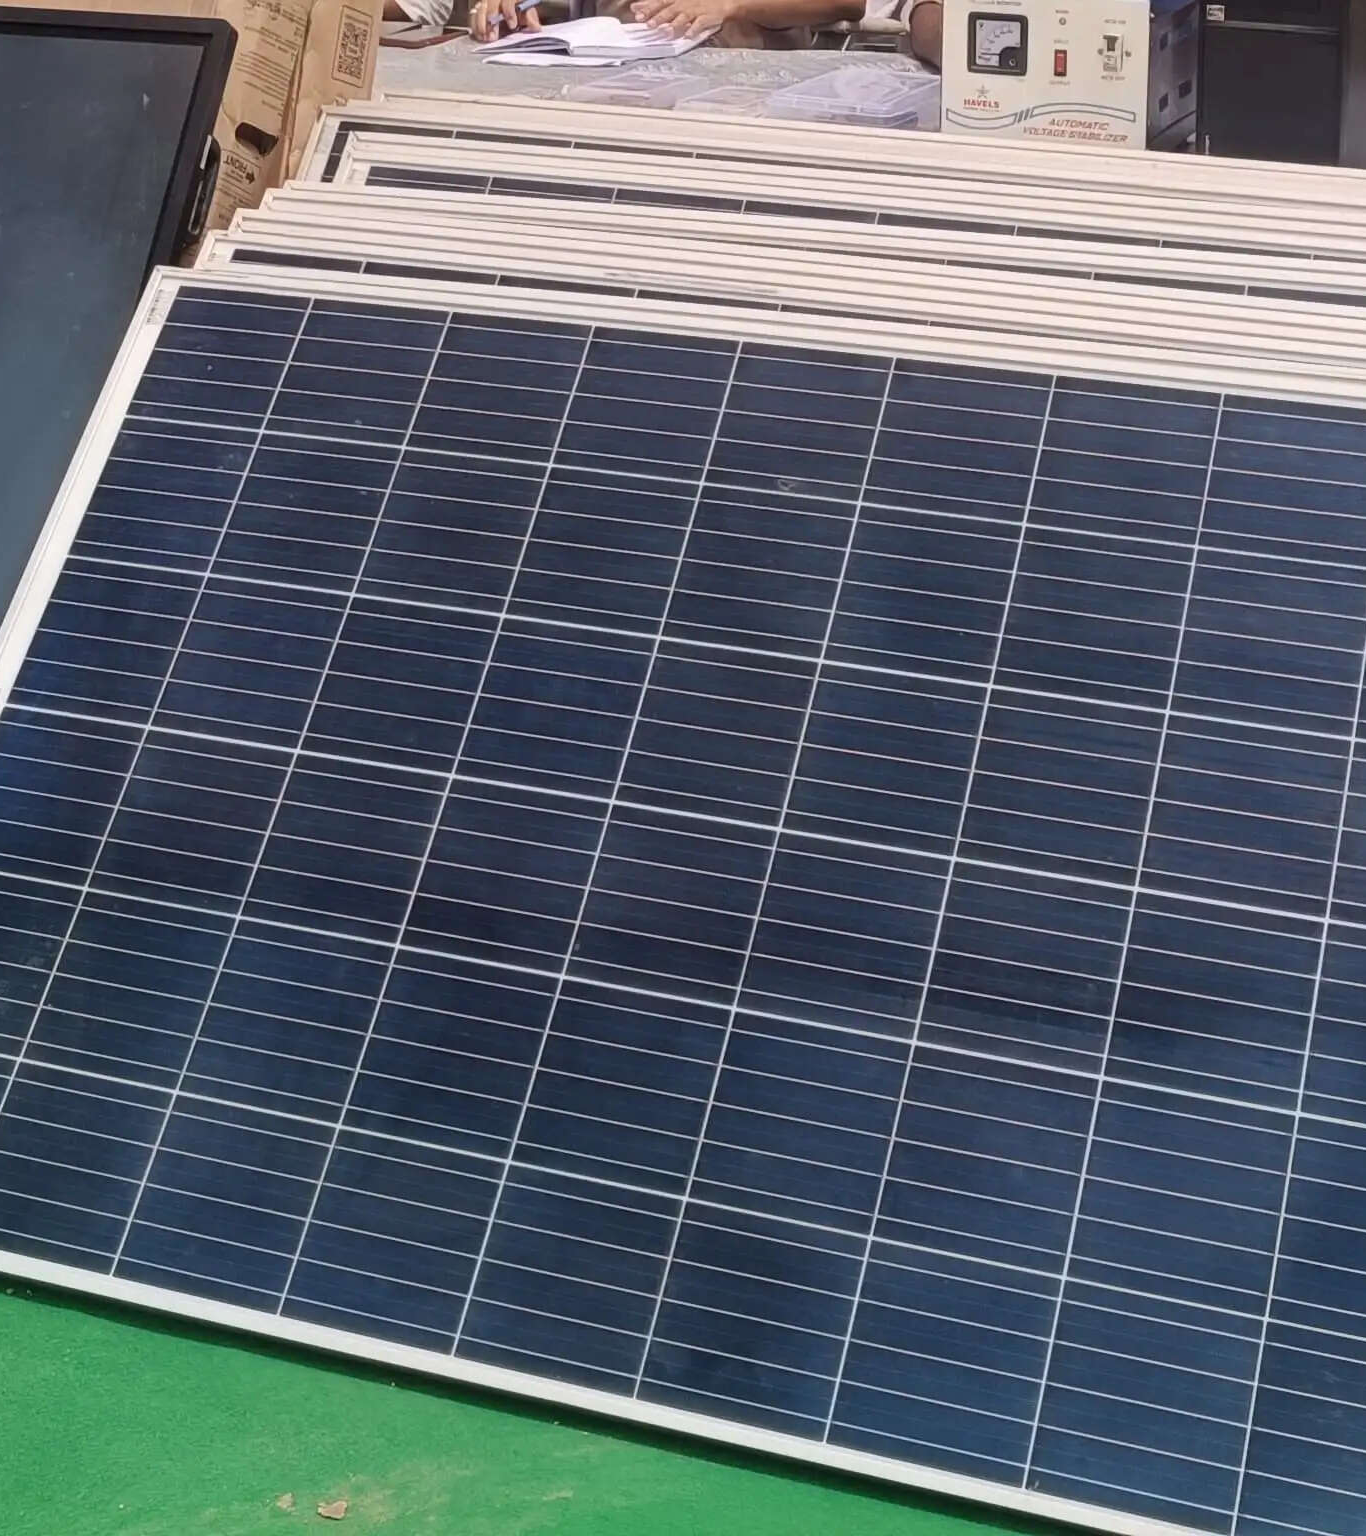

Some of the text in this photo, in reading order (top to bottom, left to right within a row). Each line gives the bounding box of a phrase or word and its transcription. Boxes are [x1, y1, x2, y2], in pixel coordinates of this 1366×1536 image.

[1048, 117, 1110, 131] AUTOMATIC
[1023, 126, 1129, 144] VOLTAGE STABILIZER
